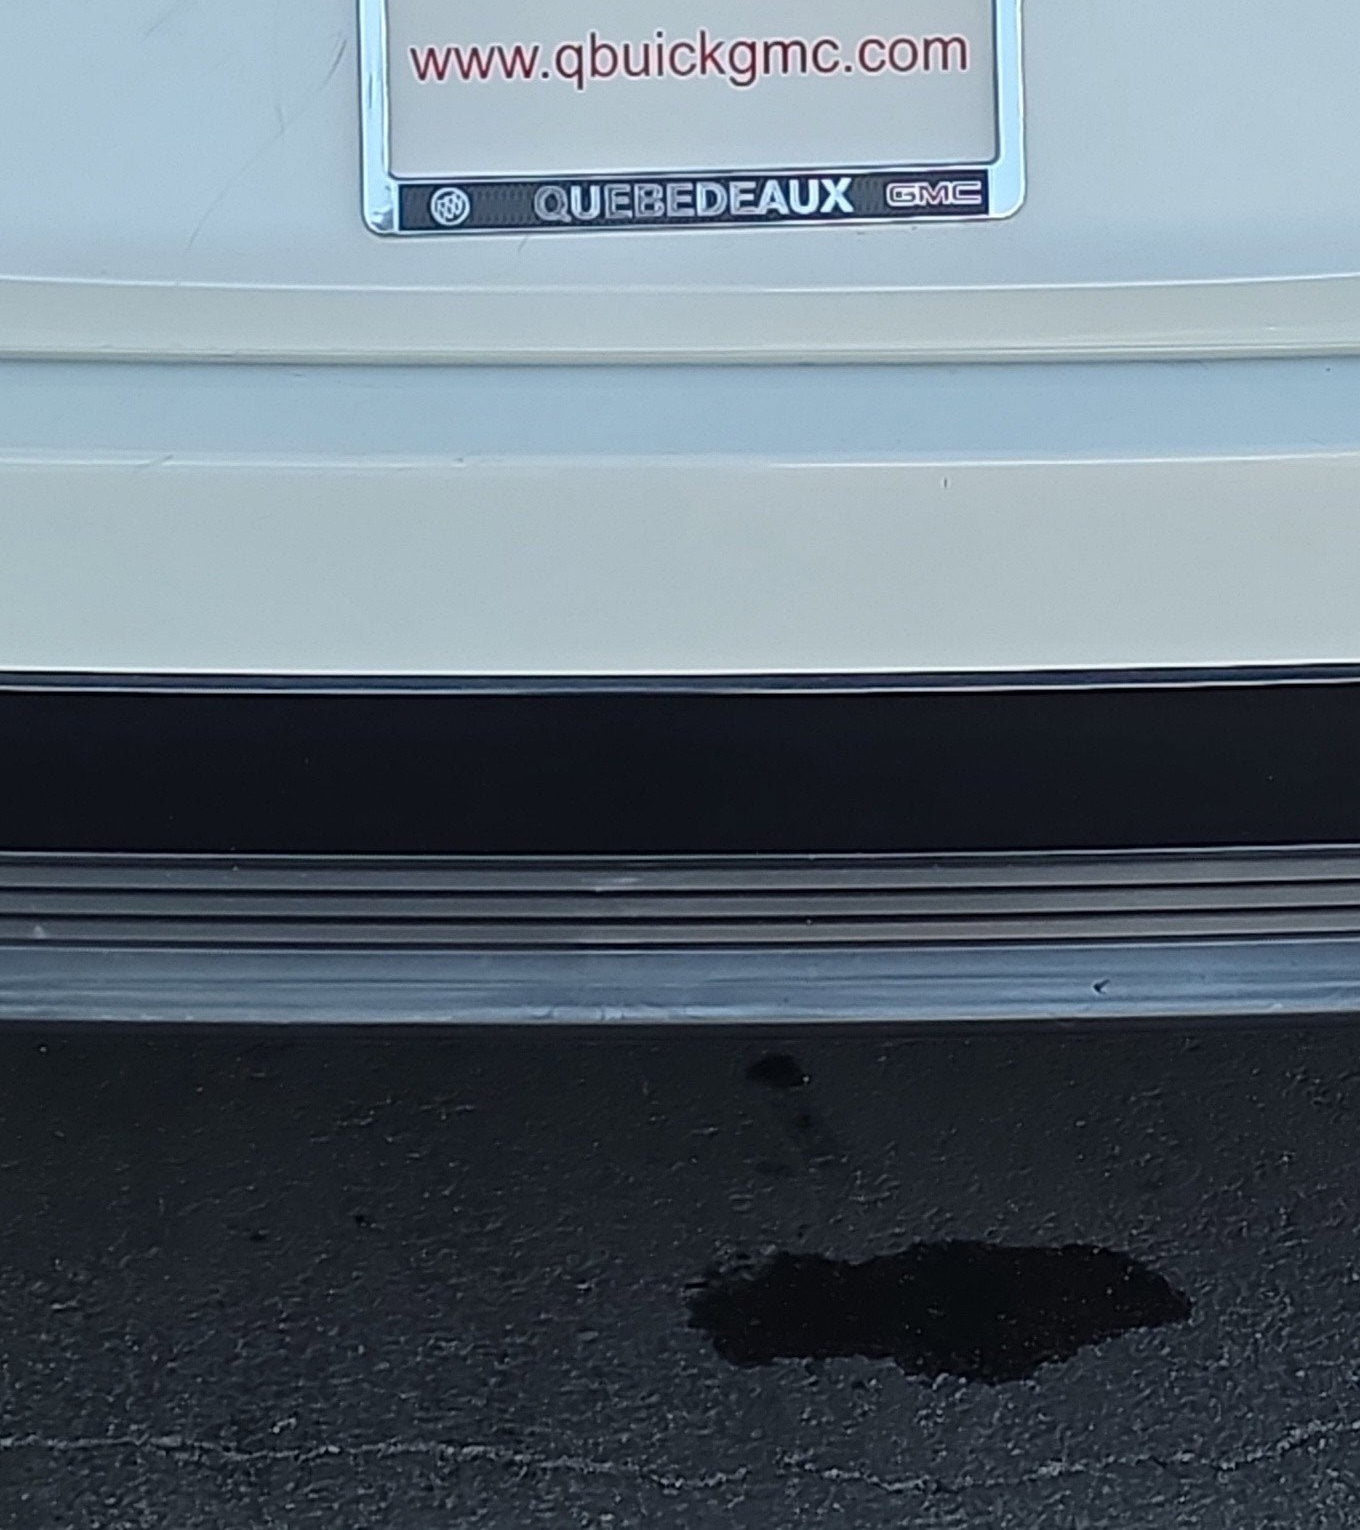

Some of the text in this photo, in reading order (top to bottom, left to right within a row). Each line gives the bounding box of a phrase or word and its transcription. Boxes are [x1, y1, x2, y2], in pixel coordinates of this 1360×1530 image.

[409, 31, 969, 91] www.qbuickgmc.com
[533, 177, 983, 222] QUEBEDEAUX GMC
